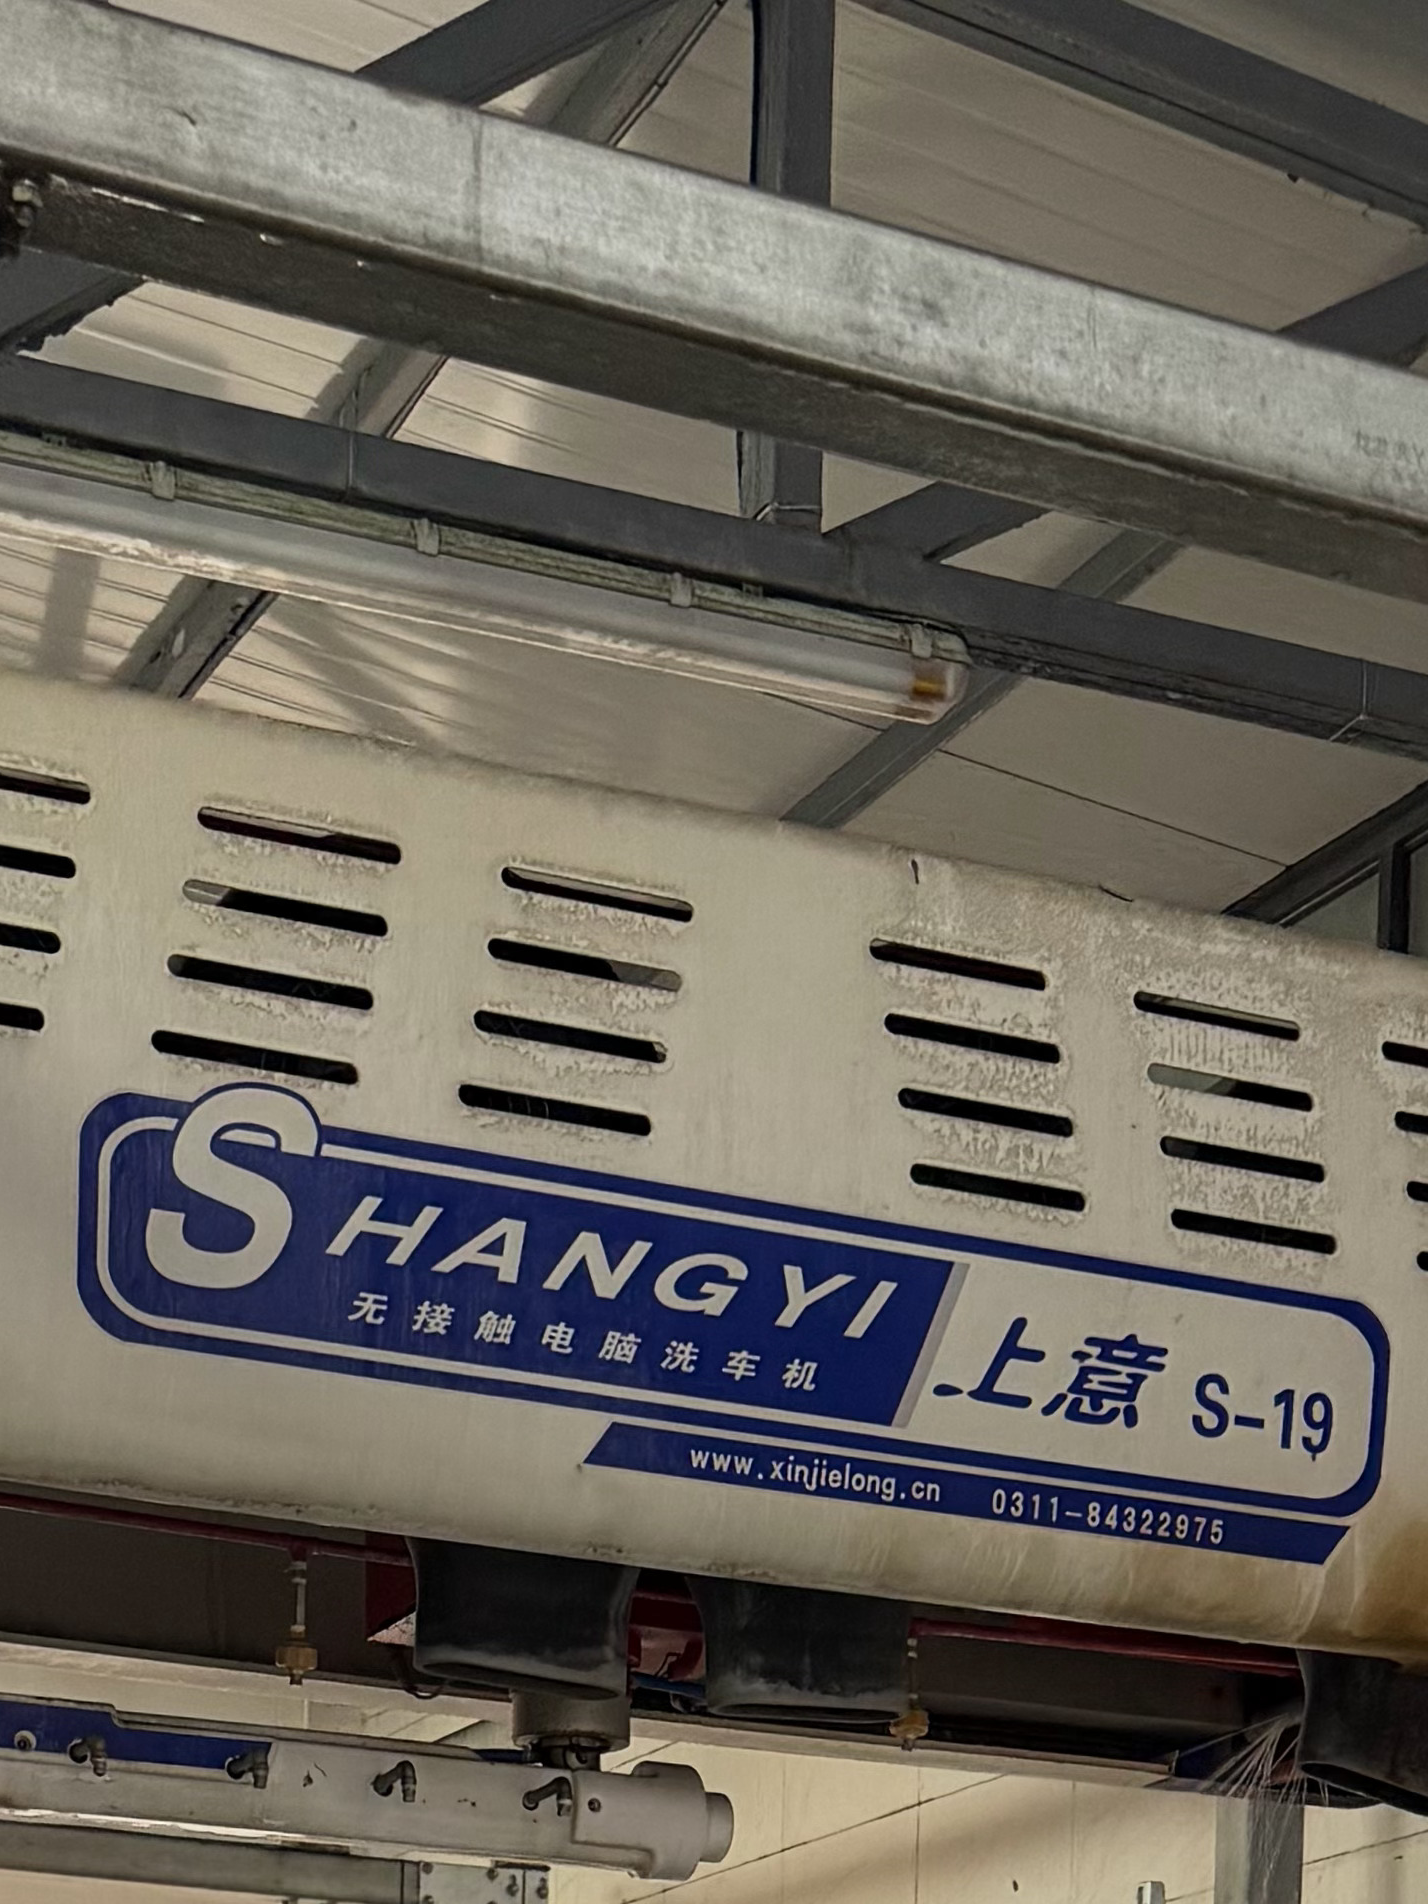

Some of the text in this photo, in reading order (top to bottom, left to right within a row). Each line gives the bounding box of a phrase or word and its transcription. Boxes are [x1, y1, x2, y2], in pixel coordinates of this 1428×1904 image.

[146, 1088, 898, 1339] SHANGYI
[348, 1292, 818, 1391] 无接触电脑洗车机
[933, 1317, 1334, 1457] 上意 S-19
[690, 1448, 1225, 1545] www.xinjielong.cn 0311-84322975
